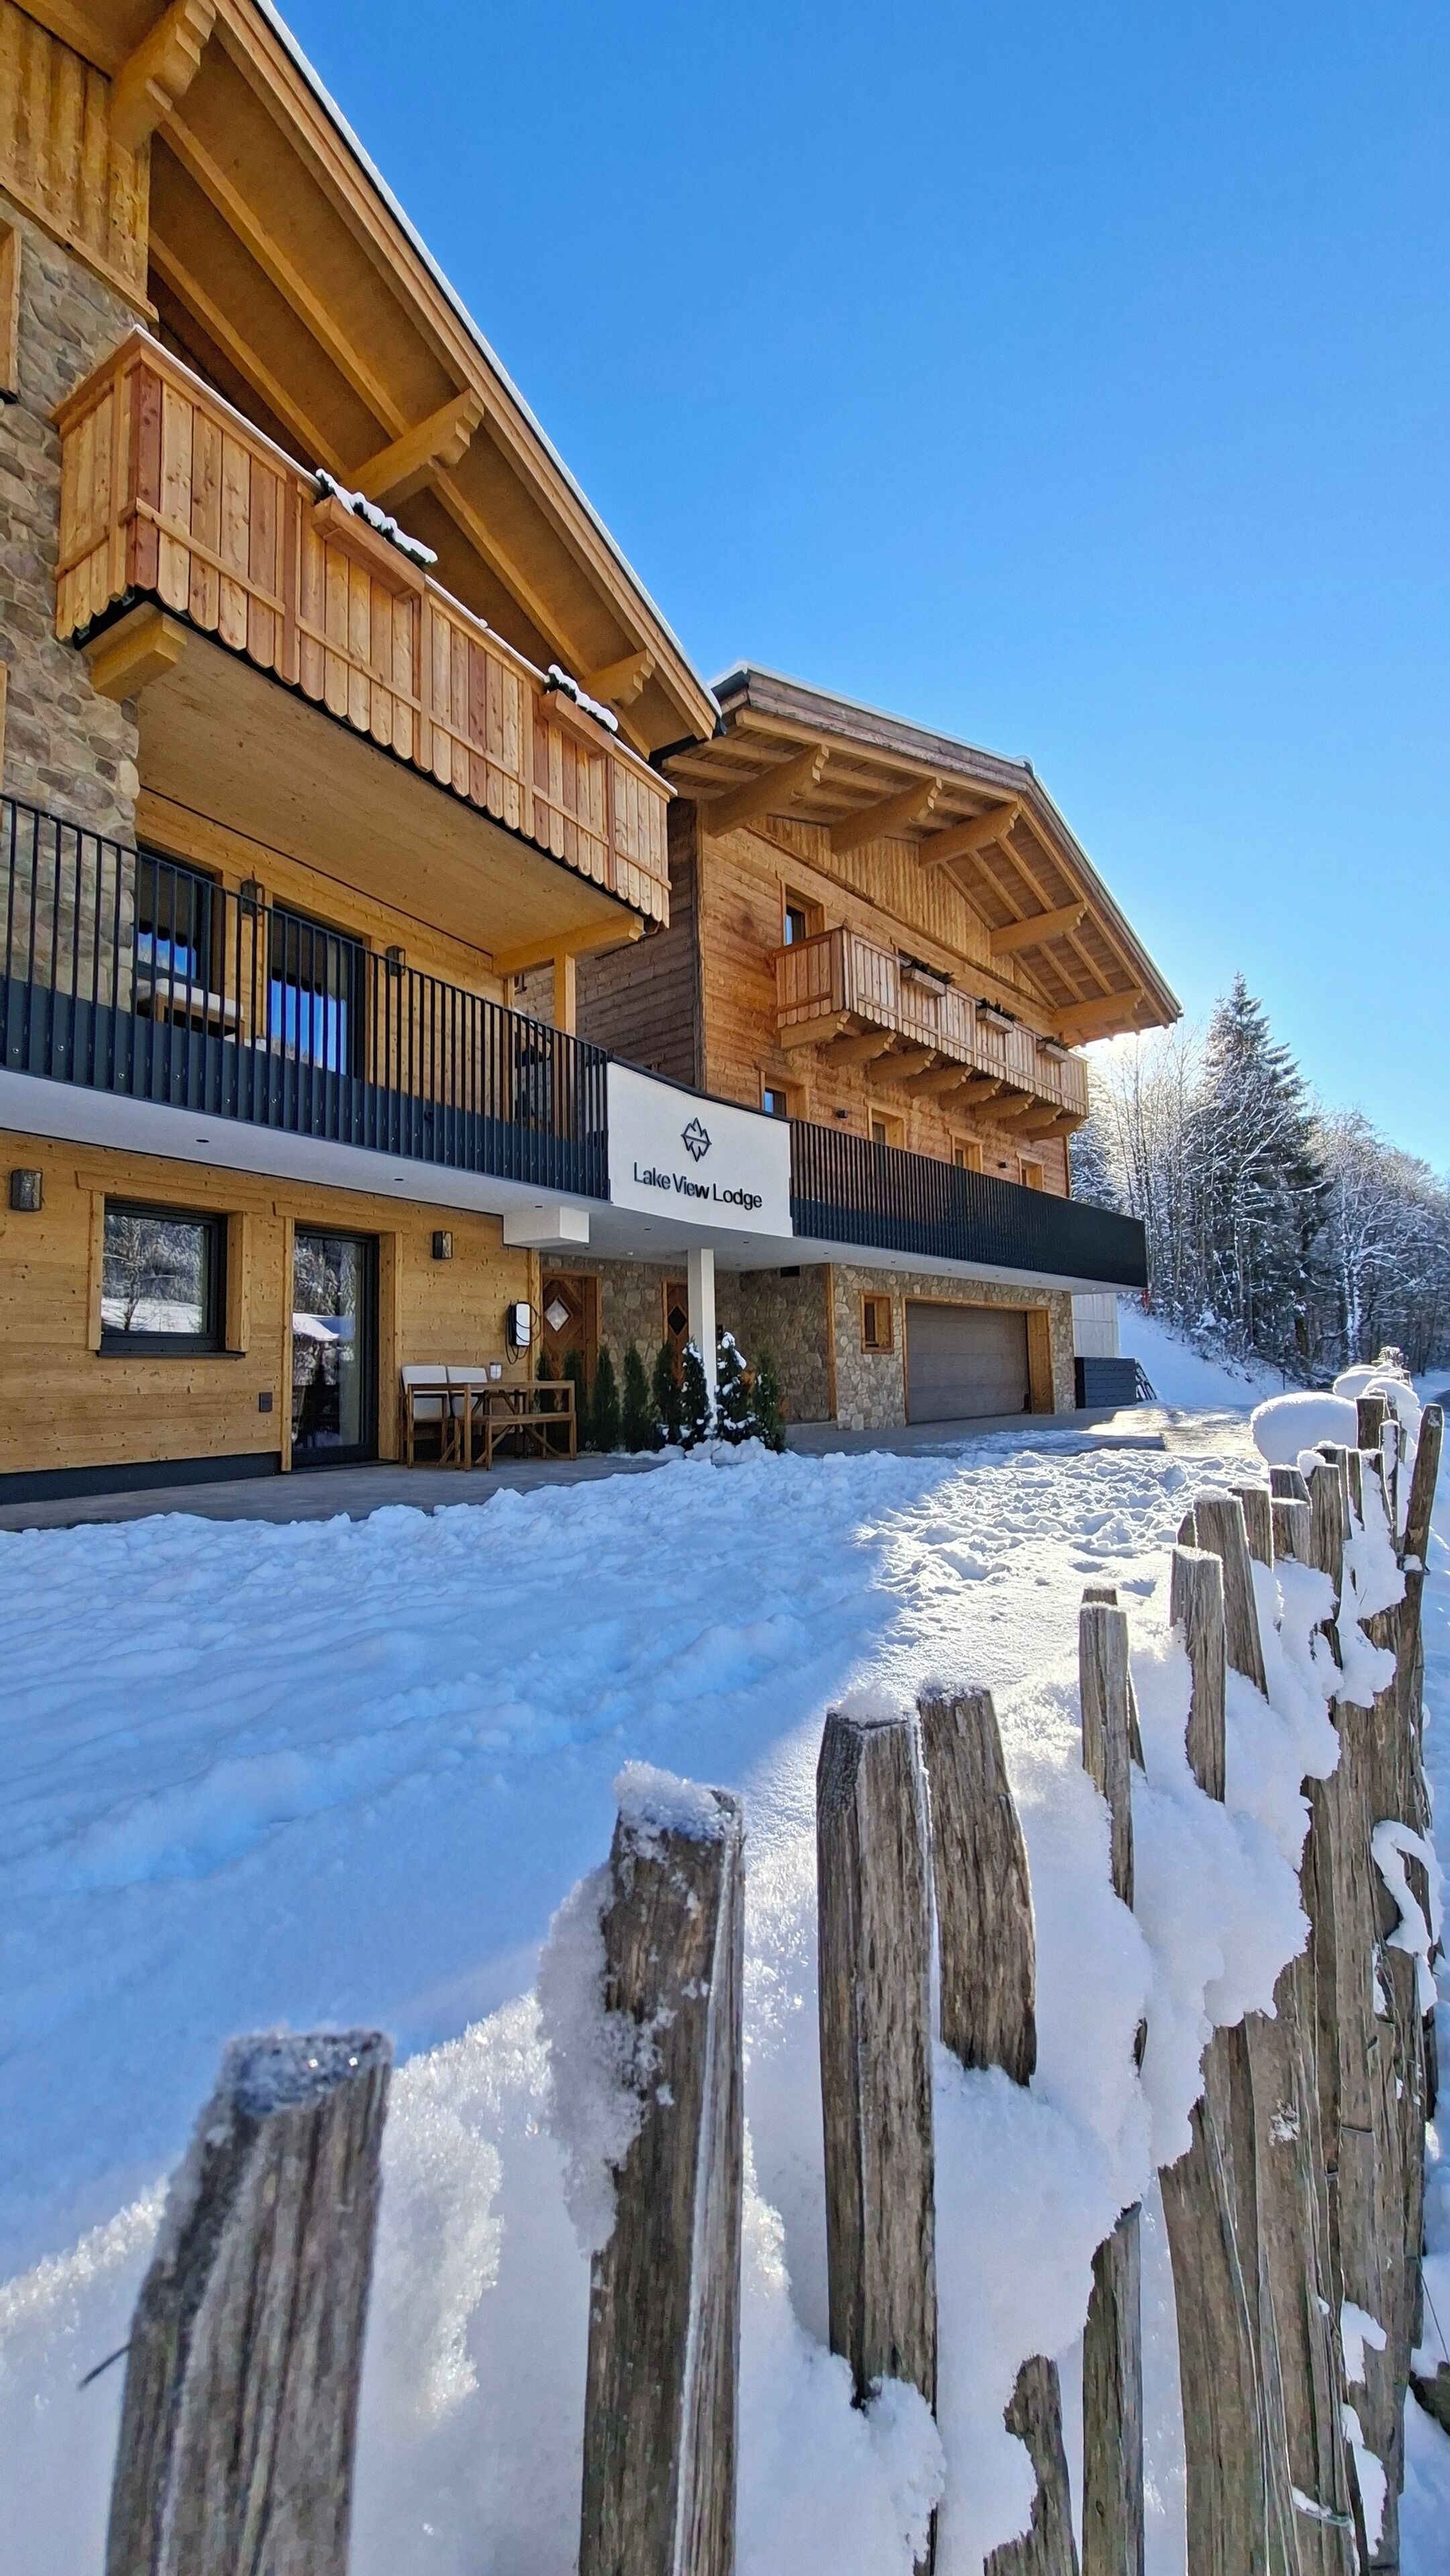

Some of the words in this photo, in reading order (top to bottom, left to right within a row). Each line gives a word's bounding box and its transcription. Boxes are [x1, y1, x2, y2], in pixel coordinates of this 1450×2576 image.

[634, 1161, 671, 1190] Lake
[672, 1173, 710, 1199] View
[713, 1183, 763, 1211] Lodge
